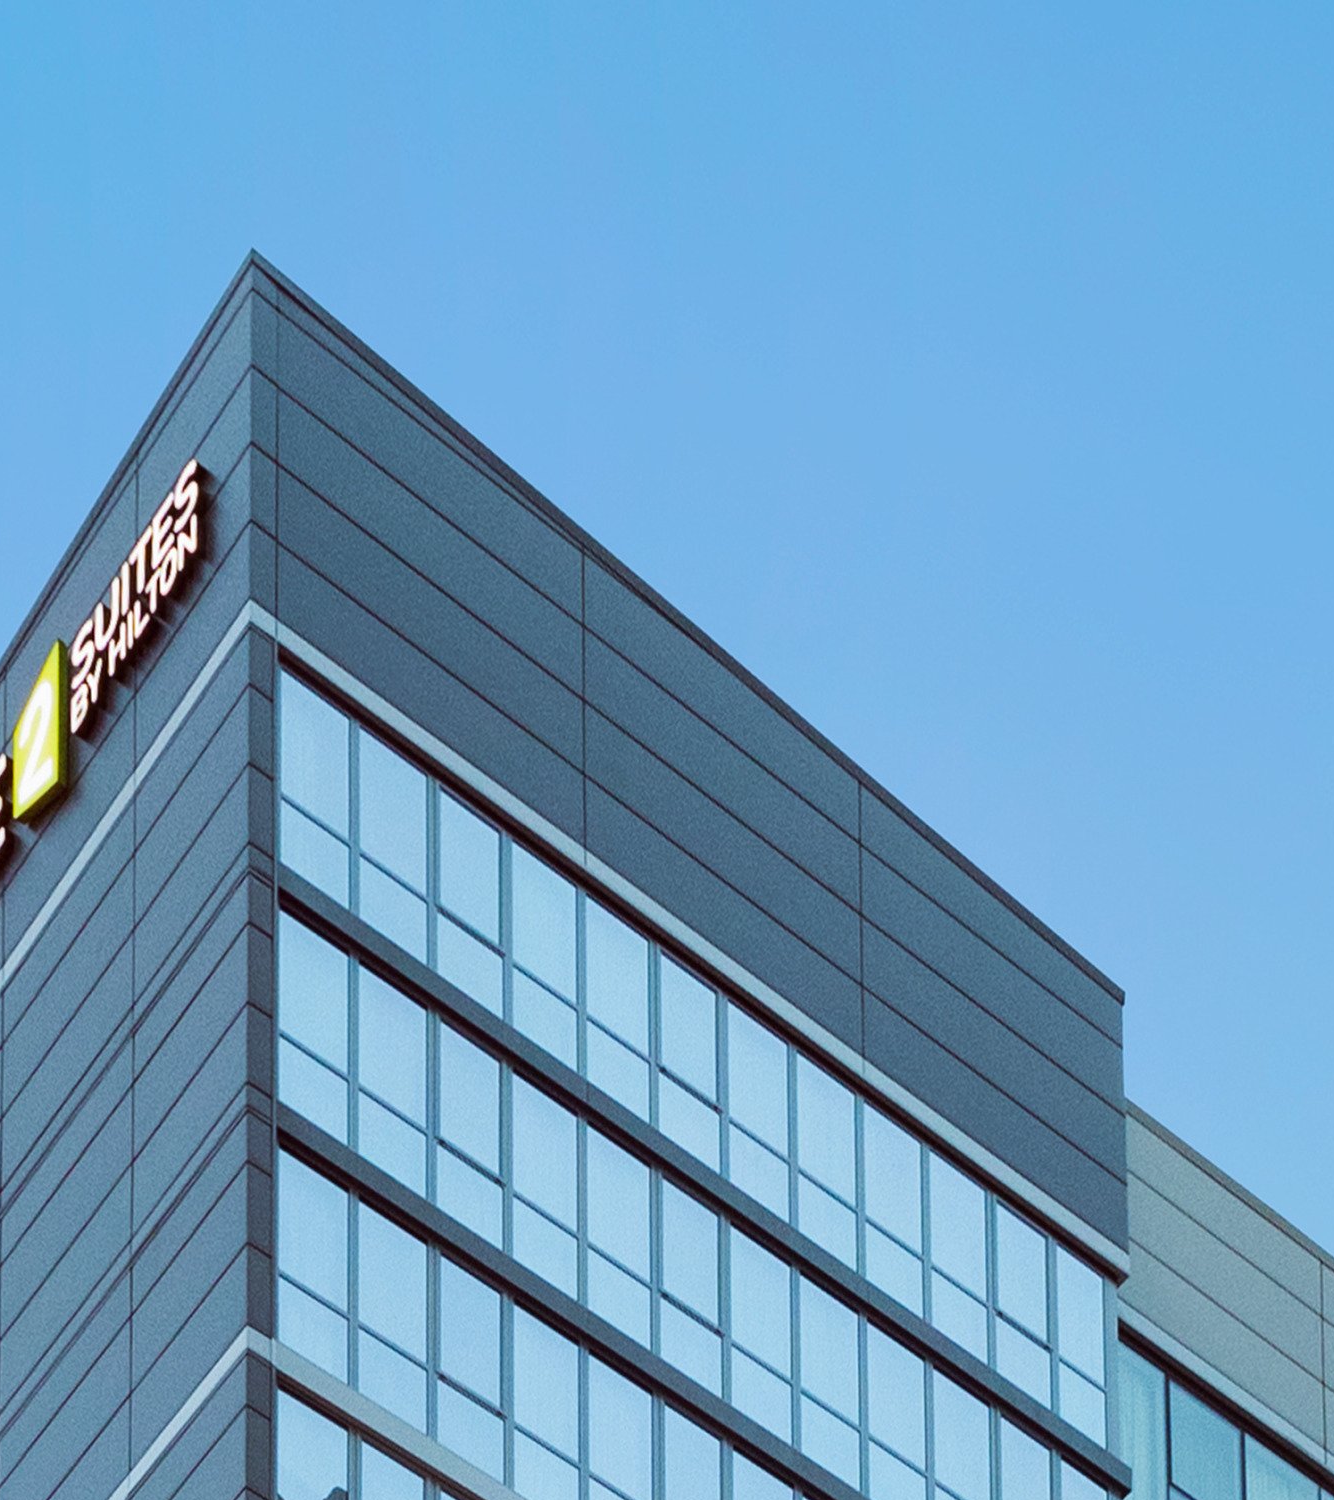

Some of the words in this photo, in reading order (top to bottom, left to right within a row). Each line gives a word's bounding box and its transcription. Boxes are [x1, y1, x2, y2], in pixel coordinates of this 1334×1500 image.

[17, 675, 57, 808] 2
[70, 458, 199, 690] SUITES
[70, 657, 103, 735] BY
[108, 512, 198, 678] HILTON
